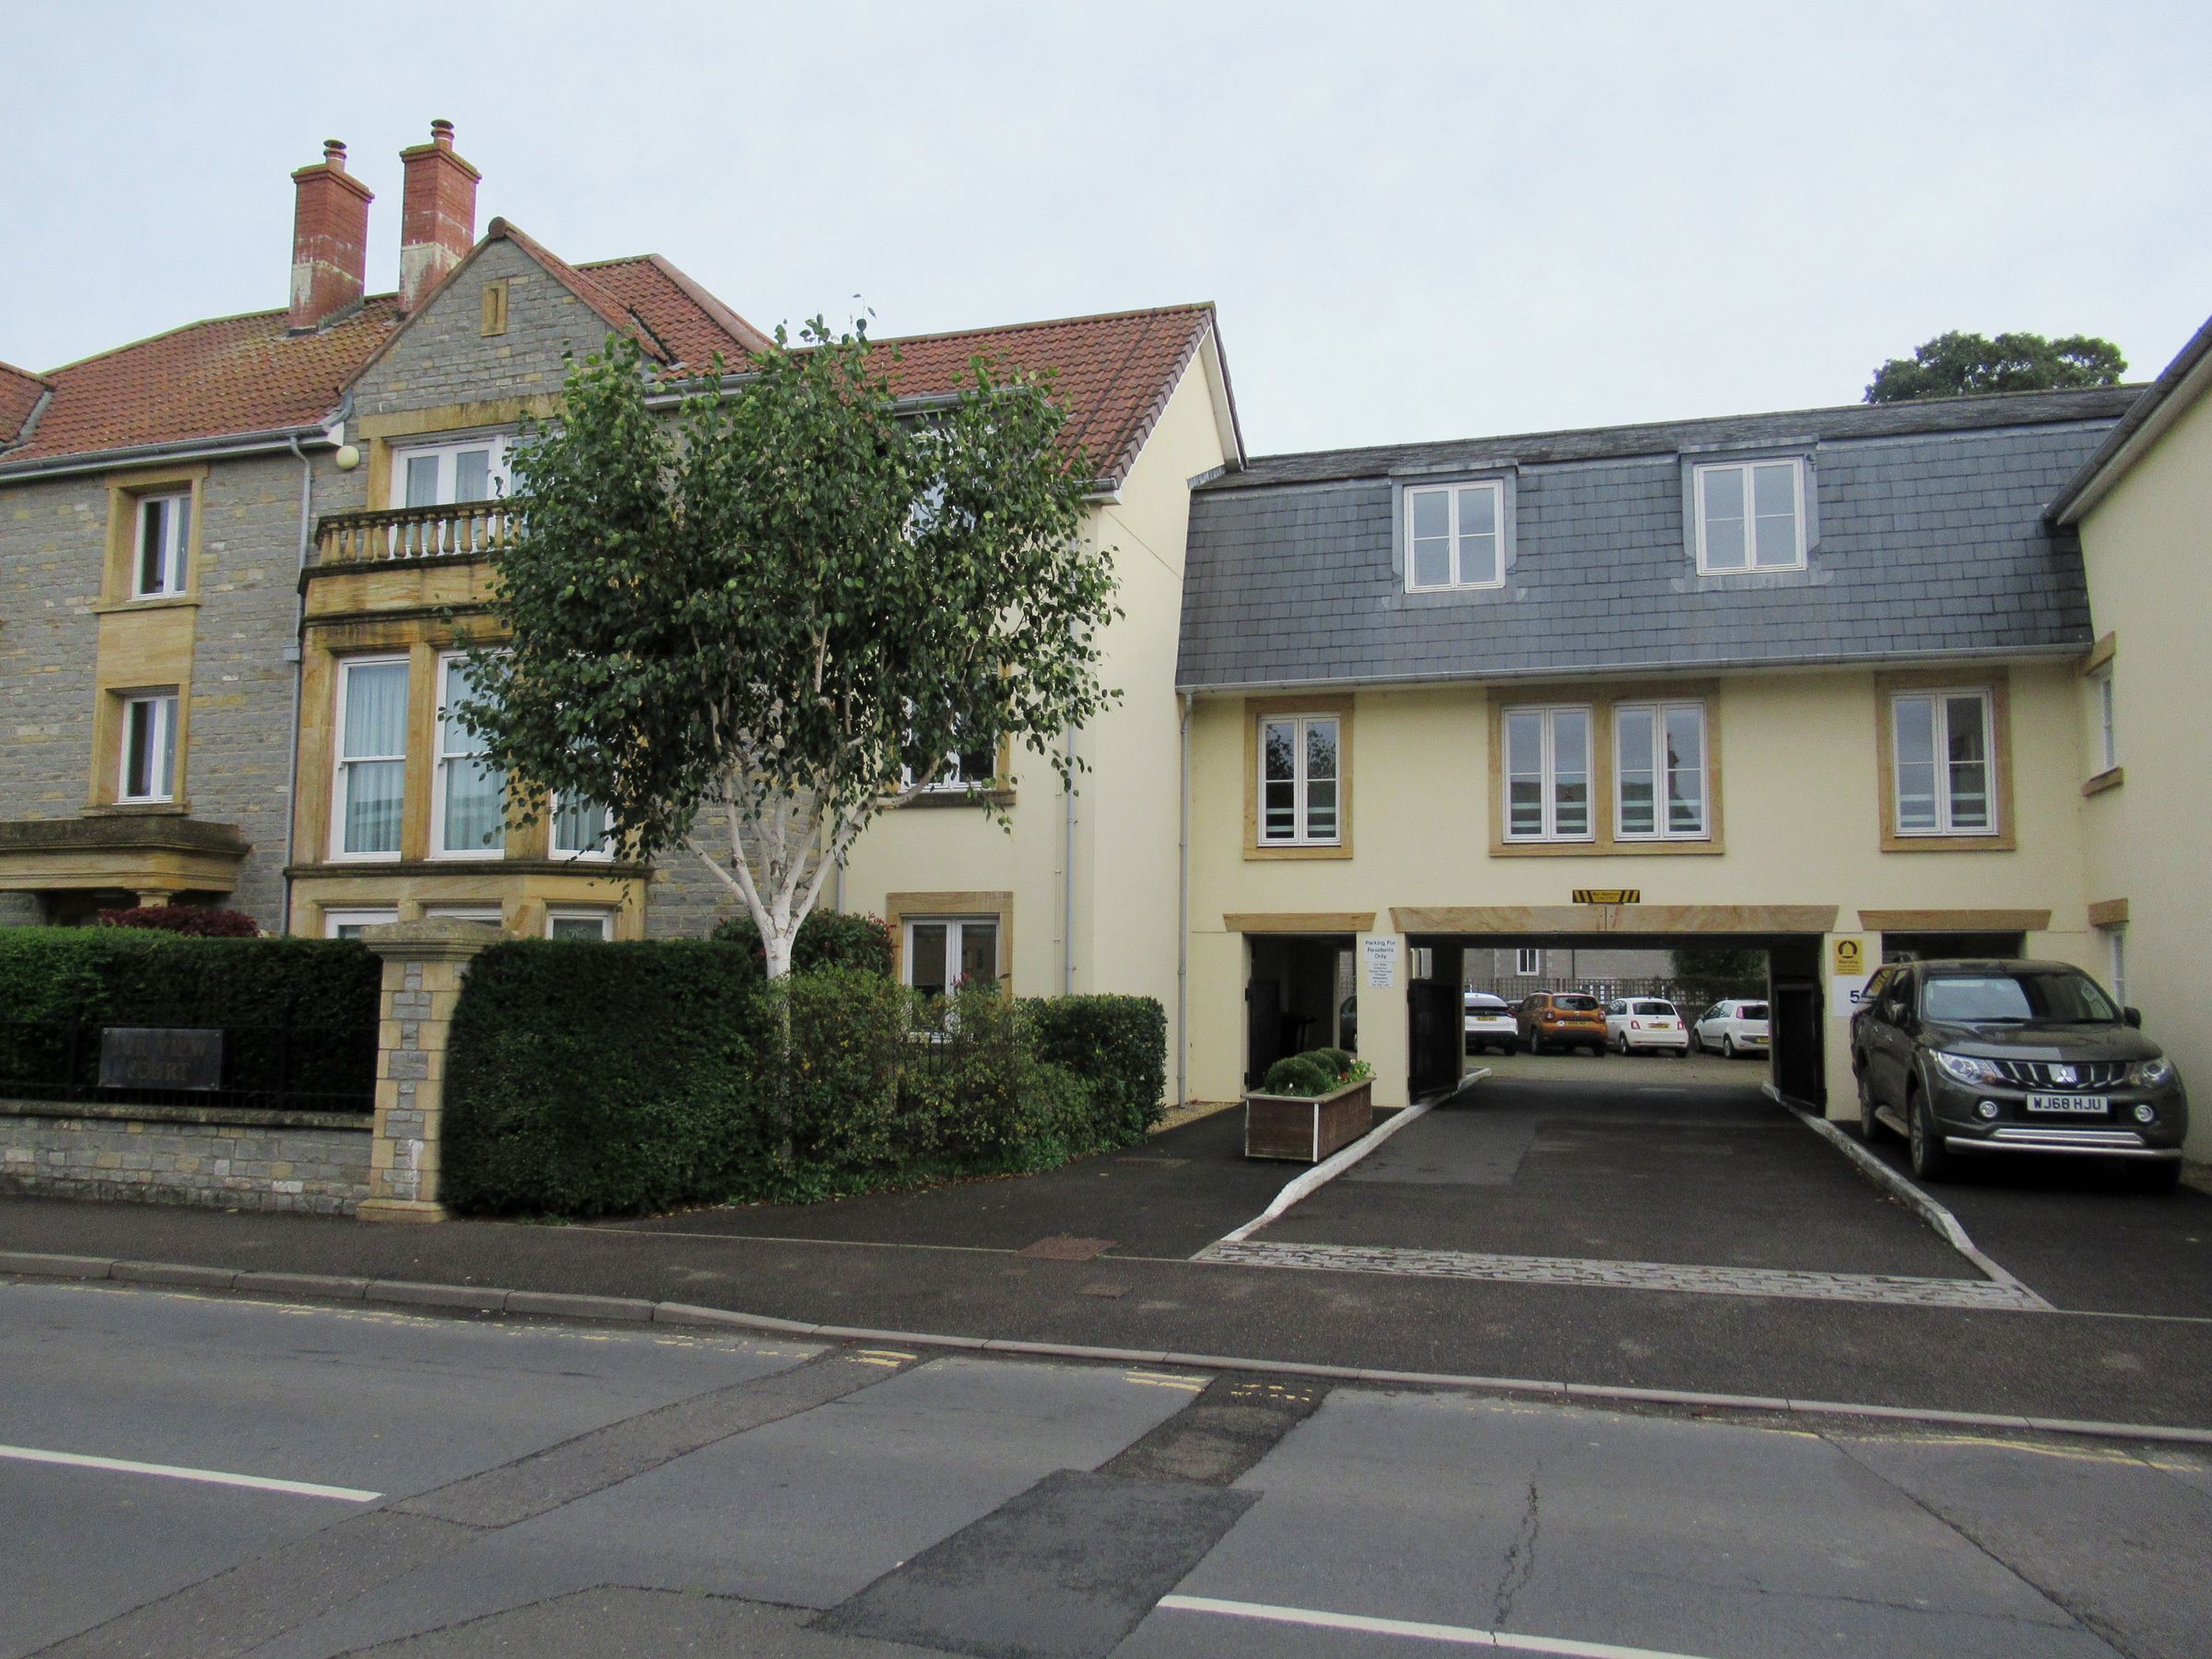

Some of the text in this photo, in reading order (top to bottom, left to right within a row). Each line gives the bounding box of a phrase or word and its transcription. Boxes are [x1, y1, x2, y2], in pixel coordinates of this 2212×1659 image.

[1850, 990, 1860, 1004] 5
[126, 1061, 191, 1081] COURT
[2033, 1097, 2101, 1111] WJ68 HJU
